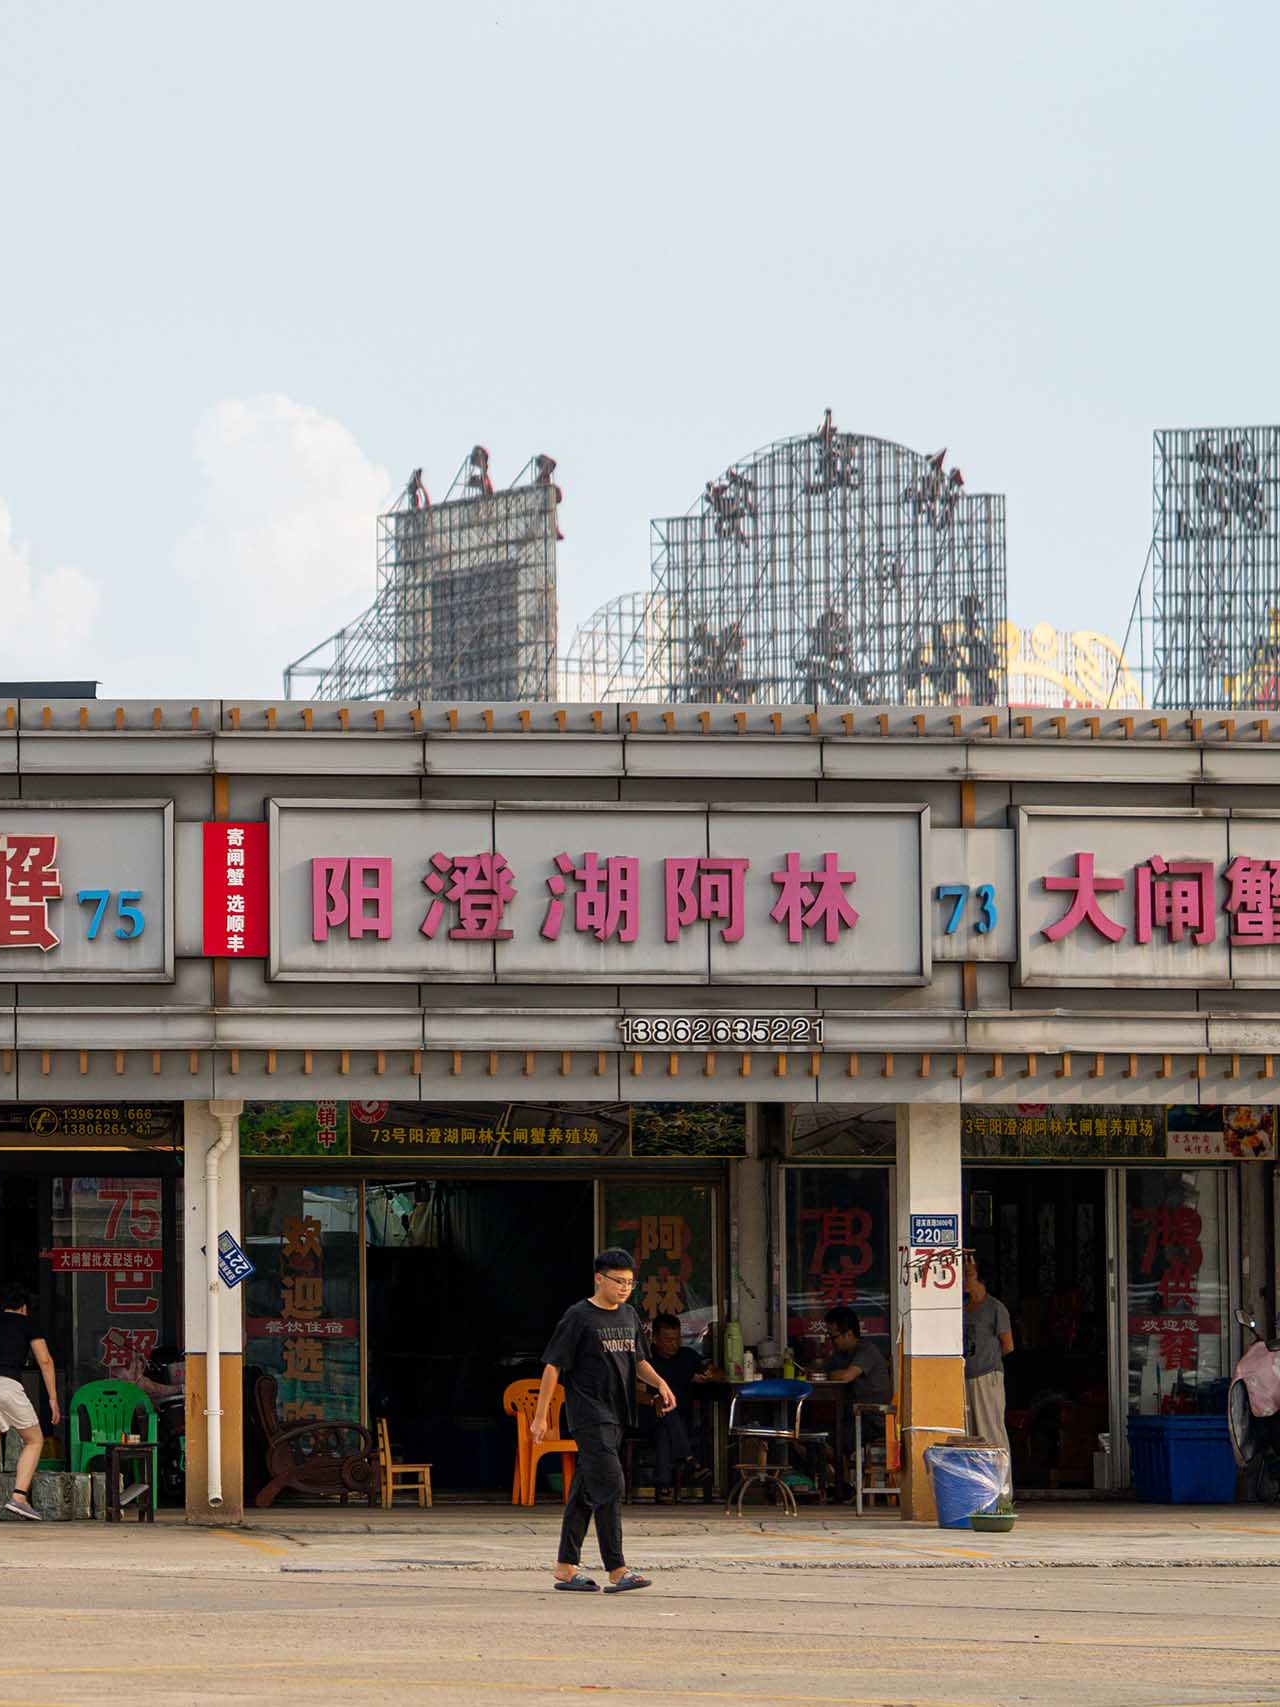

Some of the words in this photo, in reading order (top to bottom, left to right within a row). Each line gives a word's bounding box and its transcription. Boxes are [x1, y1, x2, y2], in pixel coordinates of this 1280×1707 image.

[225, 827, 245, 887] 寄闸蟹
[310, 850, 859, 944] 阳澄湖阿林
[936, 884, 998, 936] 73
[1040, 853, 1280, 947] 大闸蟹
[76, 888, 147, 942] 75
[226, 894, 245, 954] 选顺丰
[620, 1018, 825, 1043] 13862635221
[63, 1109, 153, 1120] 1396269666
[961, 1117, 1154, 1137] 3号阳澄湖阿林大闸蟹养殖场
[63, 1124, 152, 1135] 1380626541
[370, 1126, 600, 1145] 73号阳澄湖阿林大闸蟹养殖场
[97, 1190, 162, 1242] 75
[916, 1228, 941, 1243] 220
[60, 1251, 155, 1268] 大闸蟹批发配送中心
[225, 1247, 250, 1275] 221
[915, 1248, 957, 1290] 73
[264, 1320, 345, 1334] 餐饮住宿
[601, 1339, 637, 1353] MOUSE
